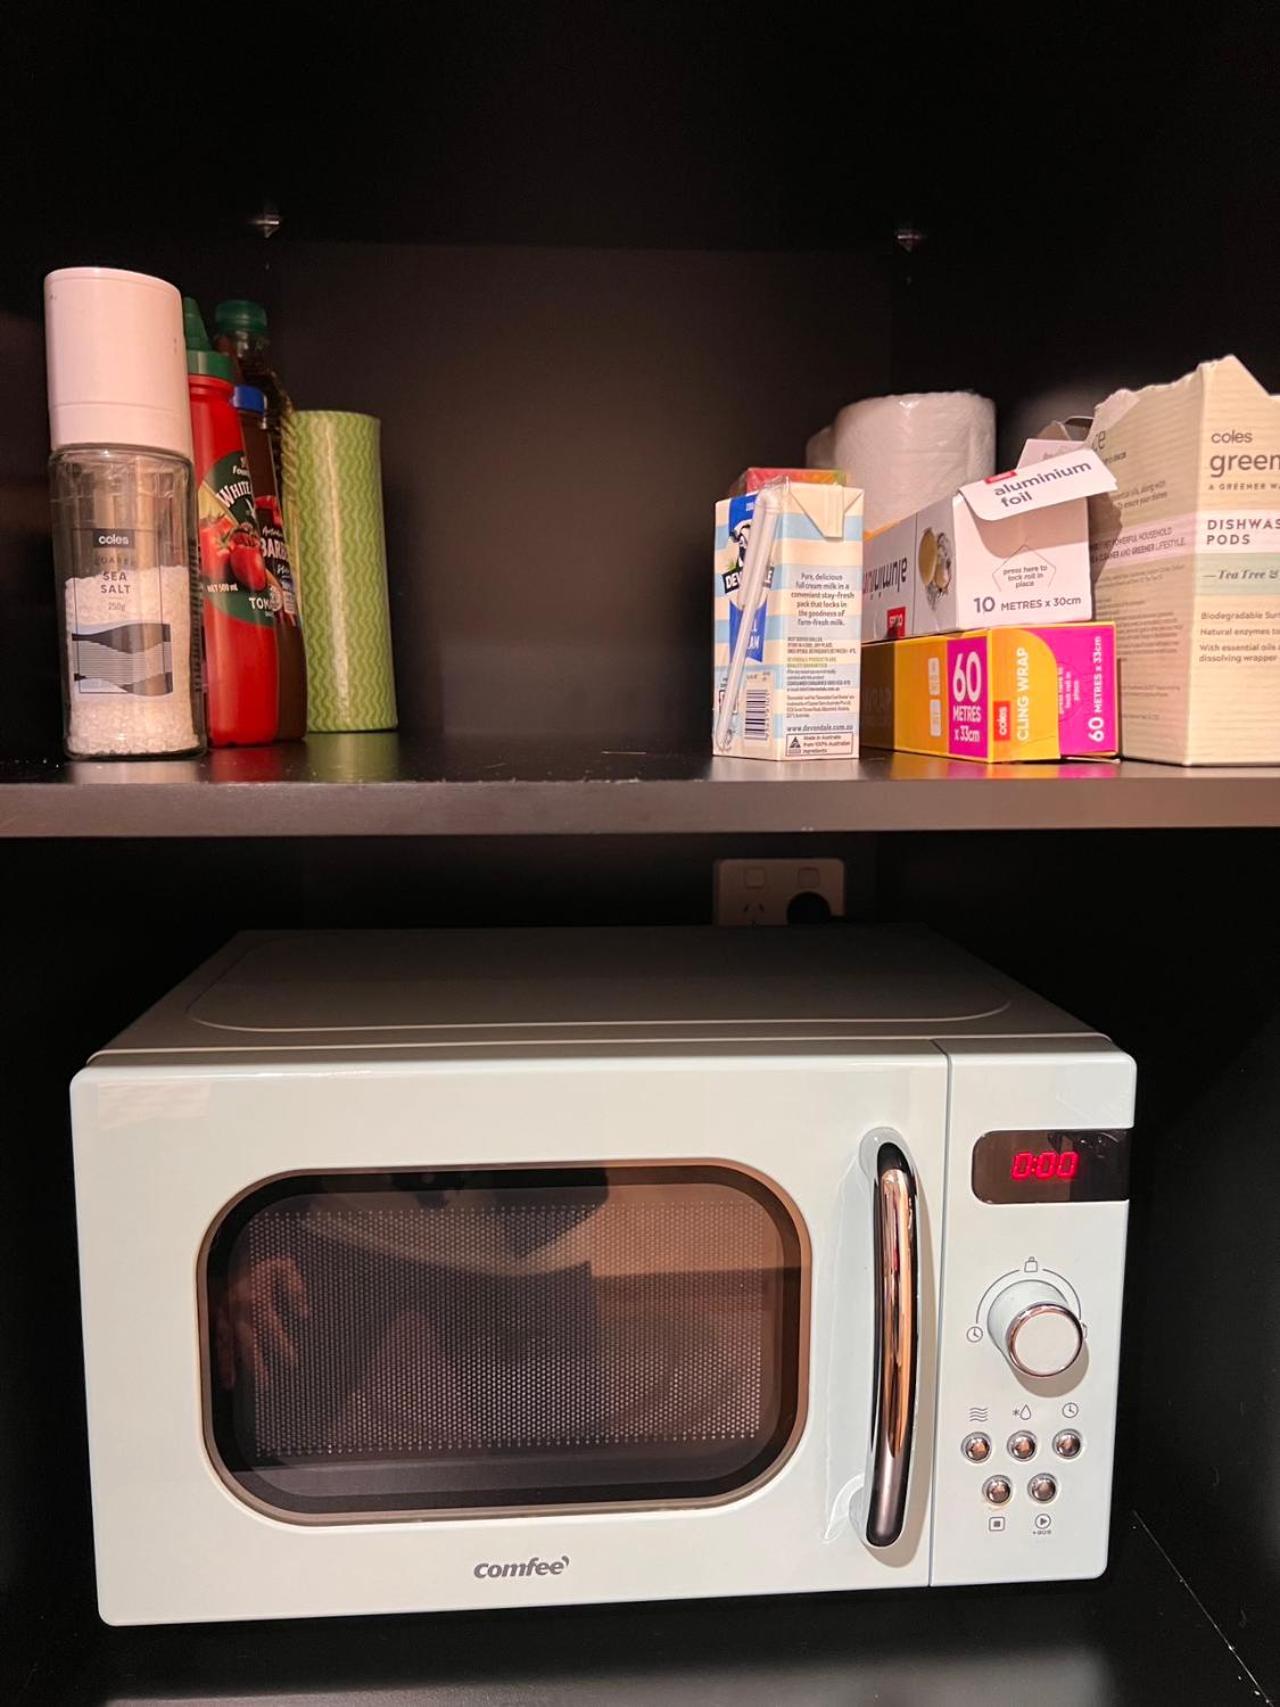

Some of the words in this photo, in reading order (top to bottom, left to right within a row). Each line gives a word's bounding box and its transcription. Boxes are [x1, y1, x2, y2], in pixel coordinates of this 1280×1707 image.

[1211, 430, 1253, 444] coles
[1209, 454, 1280, 478] green
[994, 460, 1092, 498] aluminium
[1218, 483, 1266, 491] GREENER
[1000, 489, 1033, 508] foil
[98, 534, 130, 545] coles
[1206, 533, 1251, 545] PODS
[102, 570, 128, 581] SEA
[815, 573, 843, 581] delicious
[1003, 567, 1022, 578] press
[1023, 566, 1038, 575] here
[1039, 565, 1048, 573] to
[1007, 573, 1022, 582] lock
[1023, 572, 1034, 581] roll
[1036, 571, 1044, 579] in
[1218, 569, 1239, 580] Tea
[1242, 569, 1266, 580] Tree
[100, 585, 131, 594] SALT
[1015, 579, 1035, 589] place
[821, 592, 855, 600] stay-fresh
[973, 596, 996, 613] 10
[1001, 598, 1043, 612] METRES
[1045, 600, 1052, 608] x
[1053, 596, 1082, 607] 30cm
[808, 610, 837, 618] goodness
[837, 609, 846, 617] of
[1201, 611, 1263, 621] Biodegradable
[1200, 628, 1232, 636] Natural
[1234, 628, 1270, 637] enzymes
[1092, 636, 1102, 664] 33cm
[1199, 655, 1242, 663] dissolving
[1243, 655, 1278, 663] wrapper
[1016, 647, 1030, 692] WRAP
[952, 651, 982, 703] 60
[1094, 674, 1102, 713] METRES
[953, 705, 982, 724] METRES
[999, 706, 1007, 736] coles
[1016, 695, 1030, 741] CLING
[787, 724, 854, 732] www.devondale.com.au
[954, 733, 959, 742] x
[960, 725, 981, 743] 33cm
[1088, 716, 1104, 743] 60
[1011, 1151, 1080, 1182] 0:00
